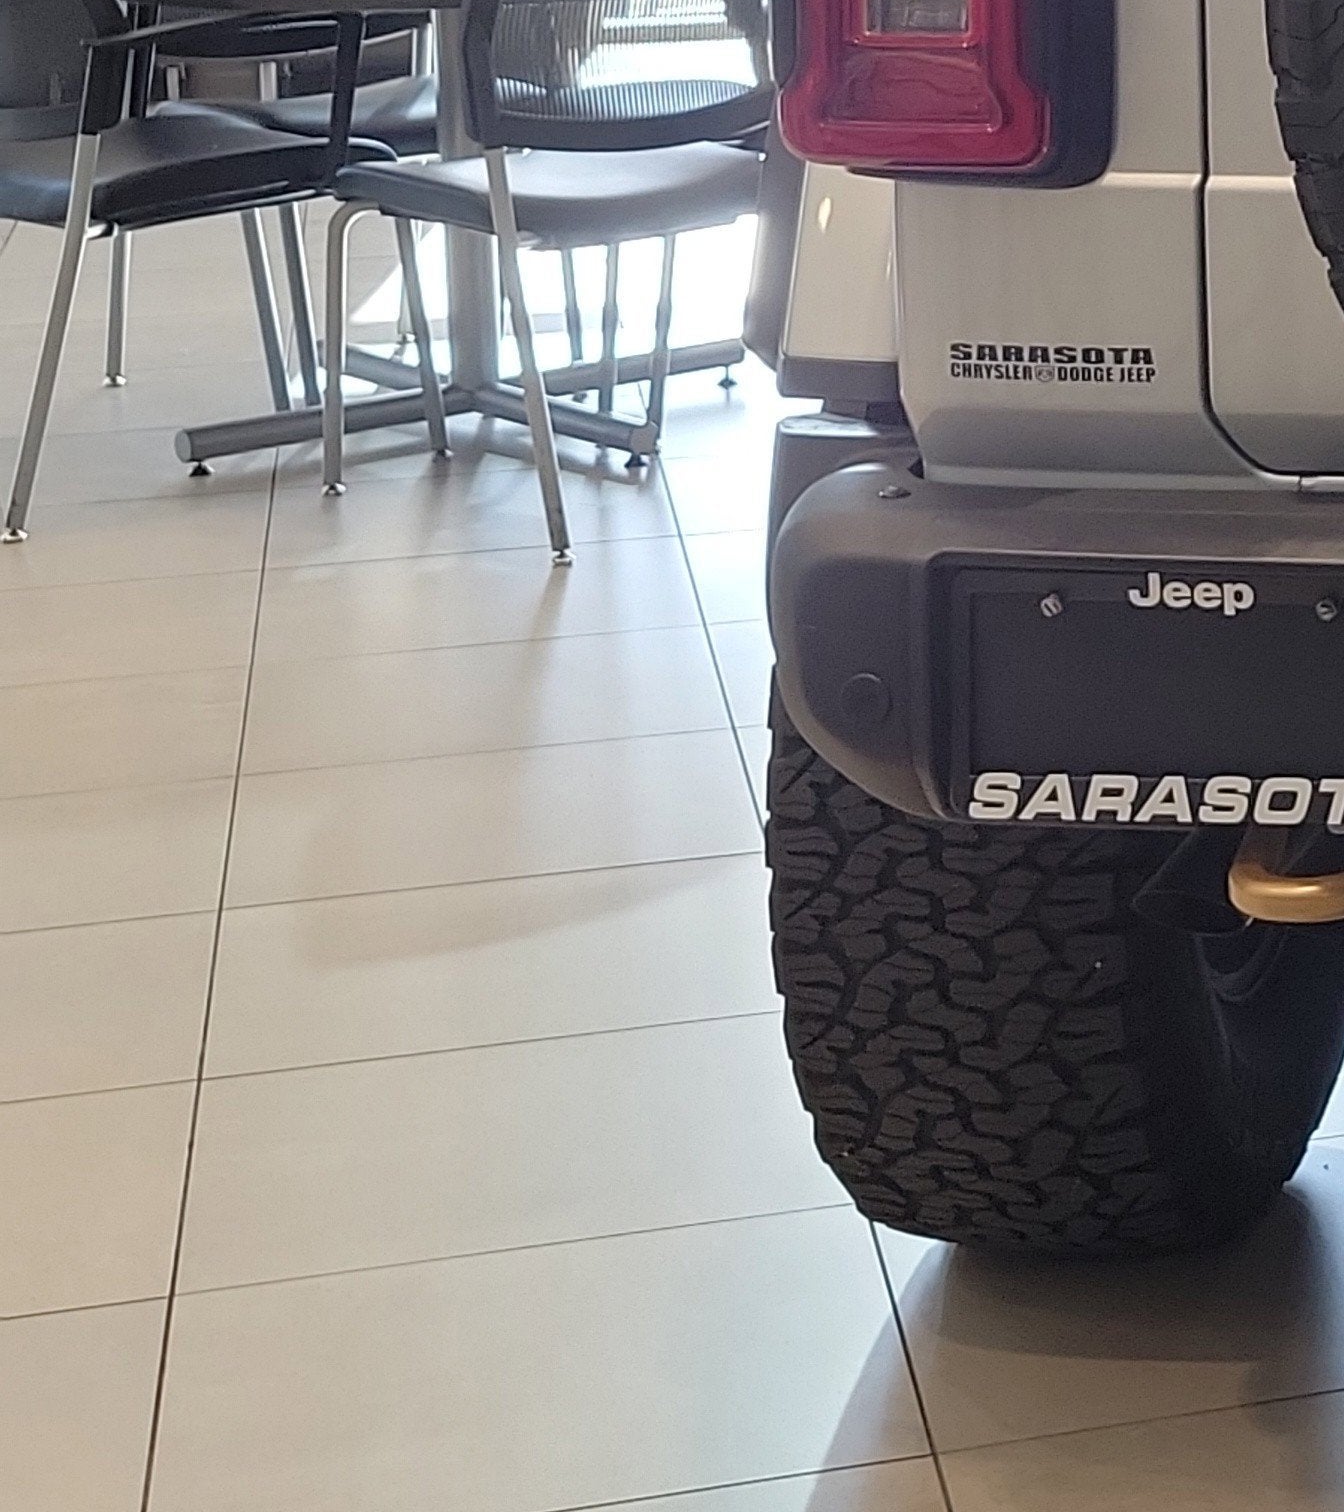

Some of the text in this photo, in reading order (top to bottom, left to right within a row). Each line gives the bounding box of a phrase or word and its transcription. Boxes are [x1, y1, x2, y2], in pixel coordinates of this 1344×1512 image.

[950, 343, 1154, 365] SARASOTA
[951, 363, 1156, 383] CHRYSLER DODGE JEEP
[1127, 572, 1255, 616] Jeep
